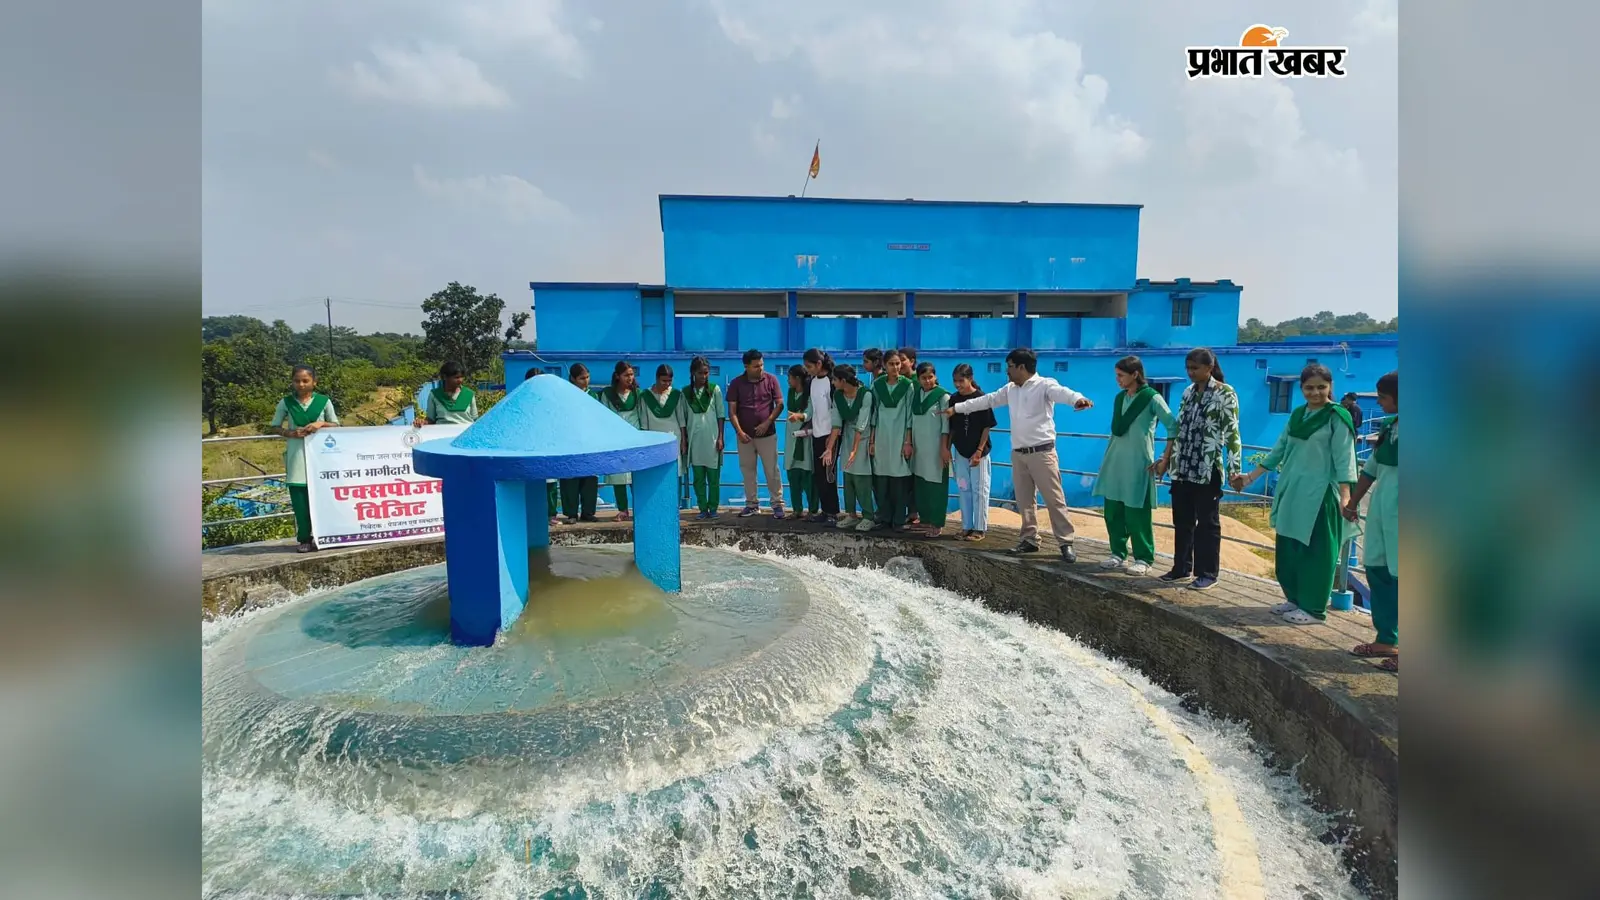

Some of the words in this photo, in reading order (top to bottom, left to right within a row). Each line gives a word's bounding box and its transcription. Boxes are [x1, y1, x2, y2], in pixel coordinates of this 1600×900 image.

[320, 469, 340, 480] जल
[343, 468, 361, 479] जन
[365, 464, 410, 477] भागीदारी
[354, 500, 427, 521] विजिट
